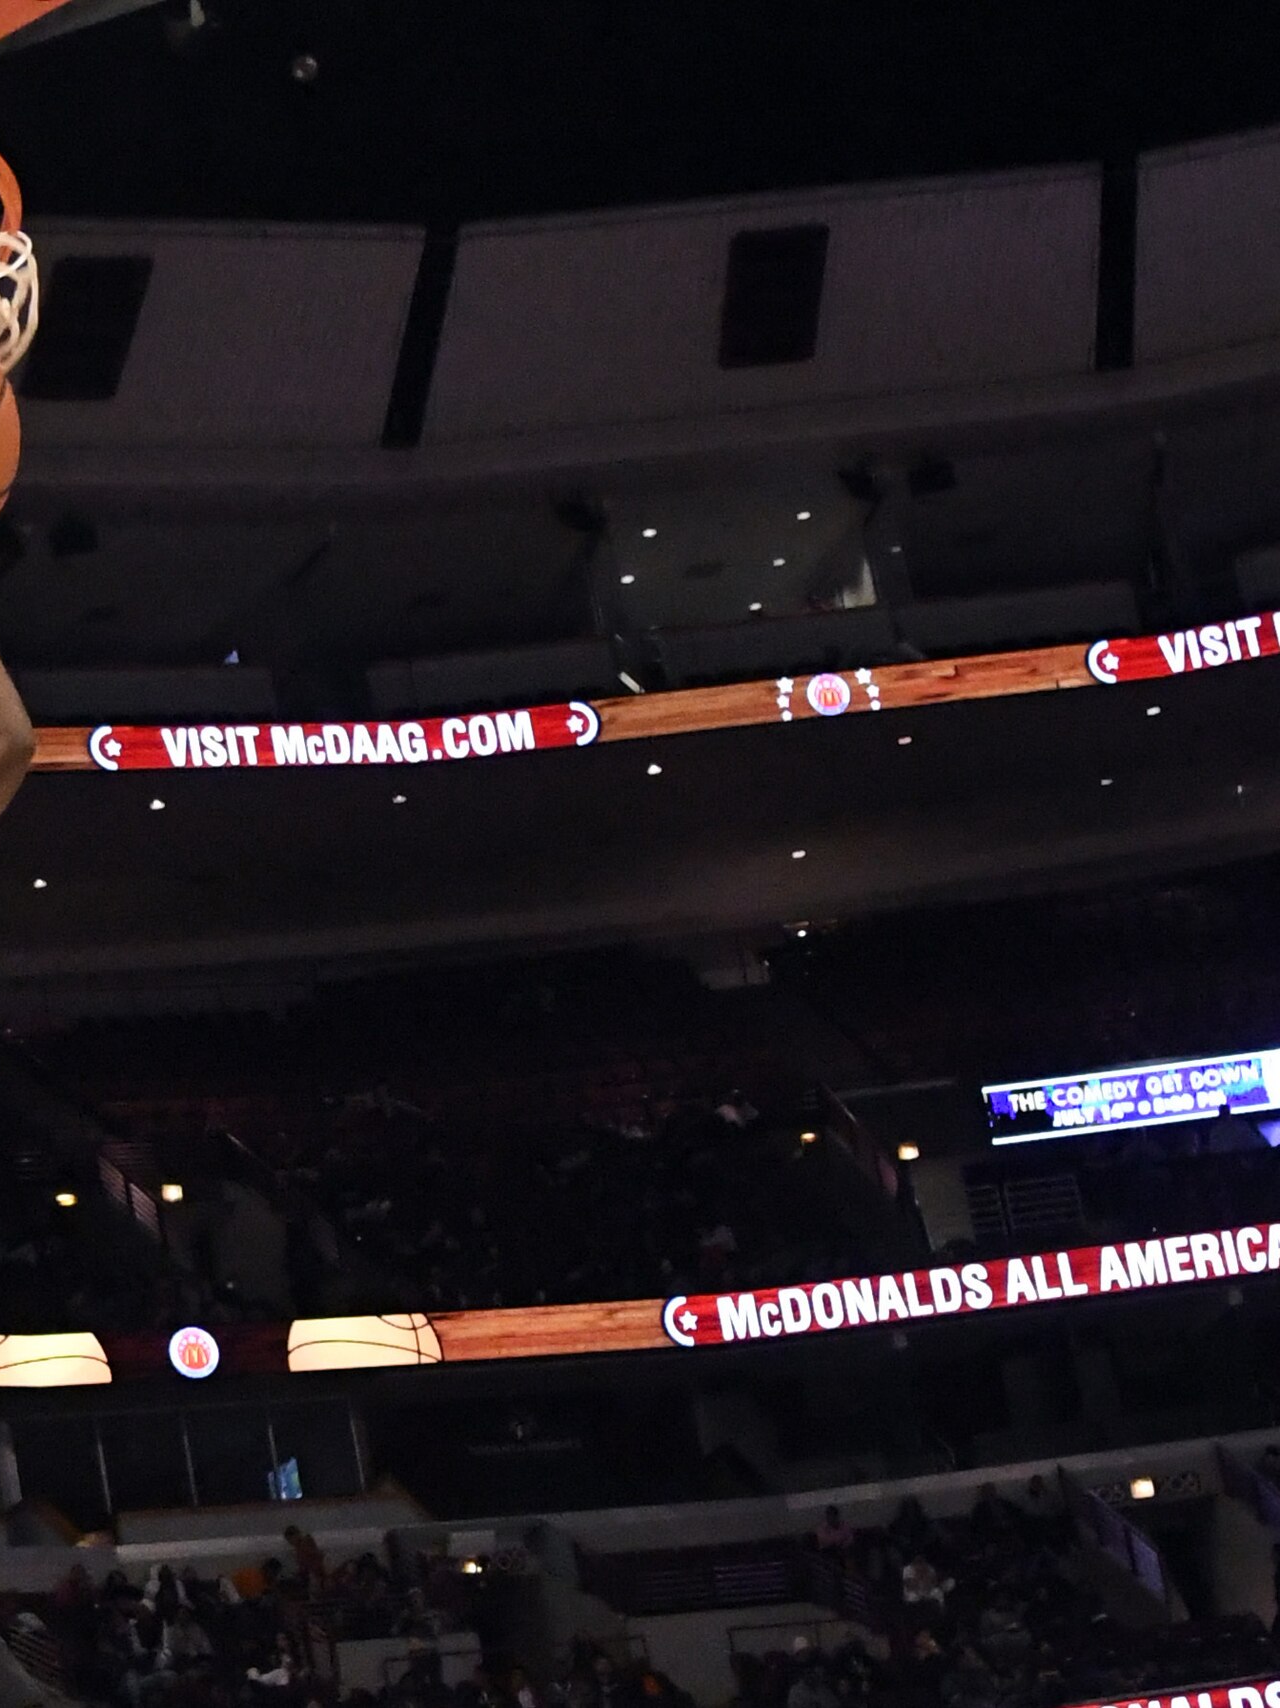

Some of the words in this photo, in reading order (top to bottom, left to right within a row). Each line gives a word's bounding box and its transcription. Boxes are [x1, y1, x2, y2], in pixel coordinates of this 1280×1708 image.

[1158, 616, 1261, 673] VISIT
[161, 725, 261, 767] VISIT
[271, 710, 536, 766] McDAAG.COM
[1007, 1092, 1047, 1114] THE
[1051, 1078, 1140, 1107] COMEDY
[1146, 1073, 1183, 1096] GET
[1190, 1064, 1260, 1090] DOWN
[716, 1262, 993, 1341] McDONALDS
[1006, 1252, 1089, 1304] ALL
